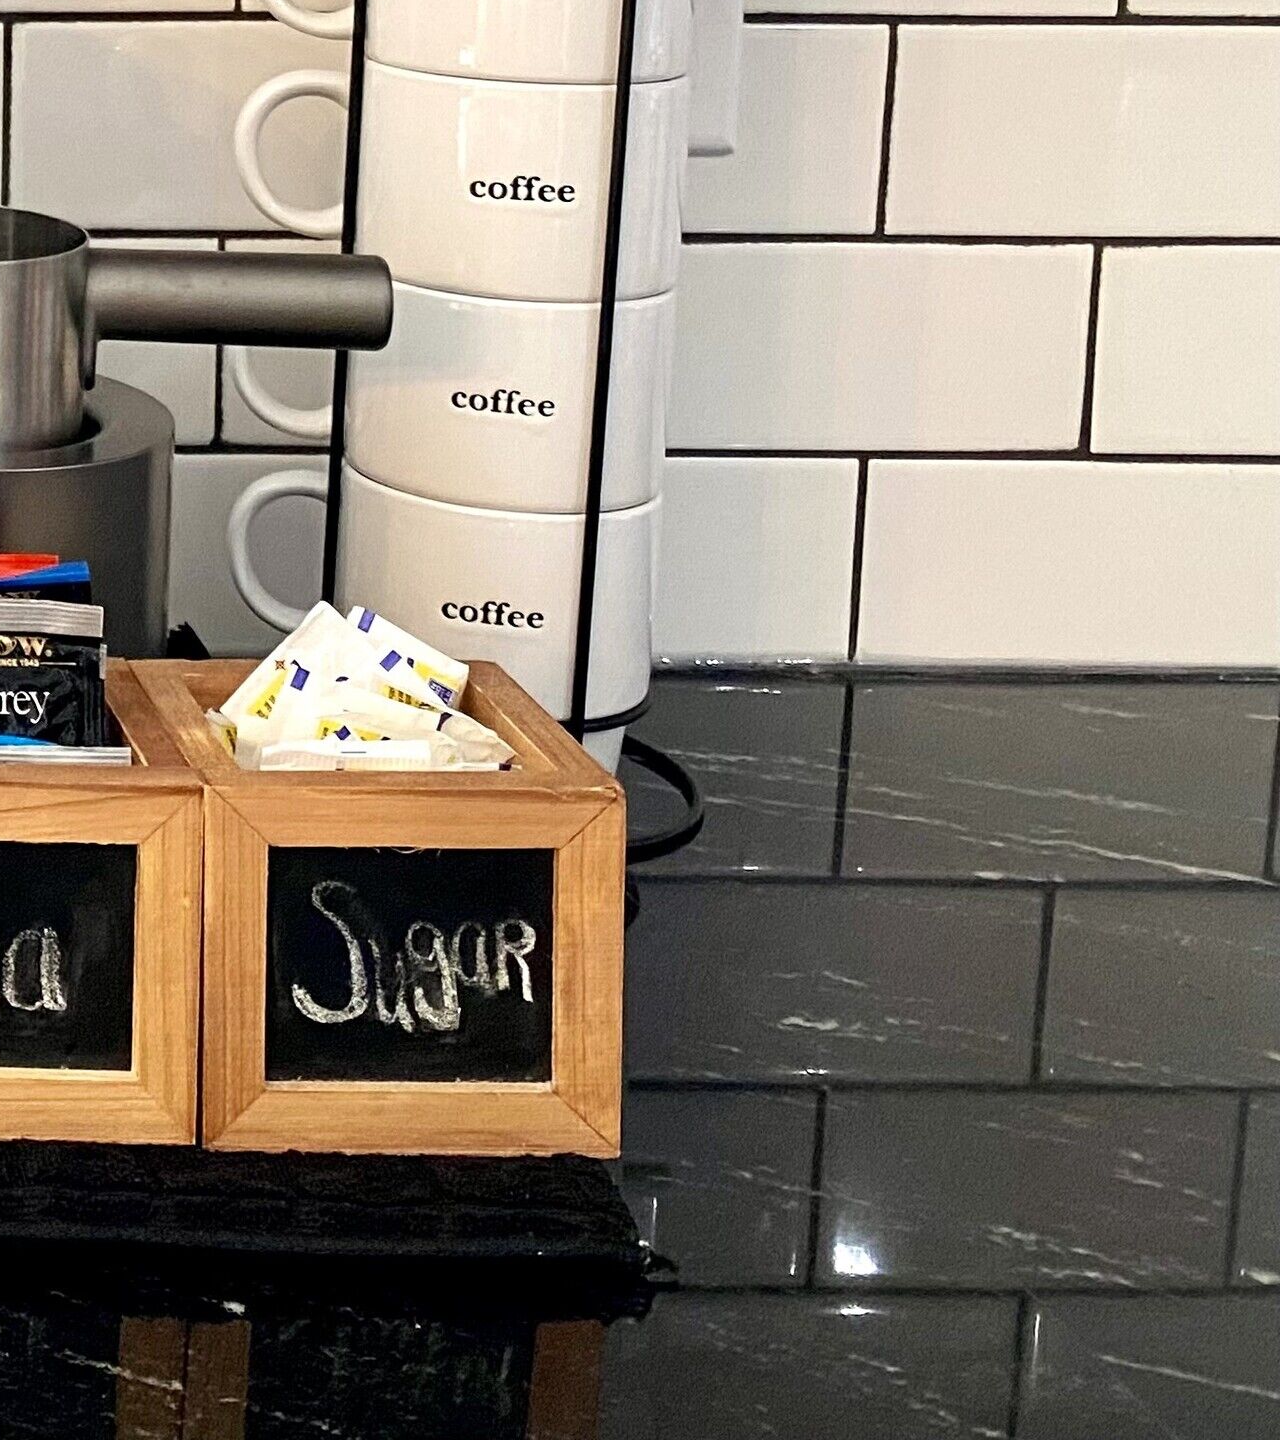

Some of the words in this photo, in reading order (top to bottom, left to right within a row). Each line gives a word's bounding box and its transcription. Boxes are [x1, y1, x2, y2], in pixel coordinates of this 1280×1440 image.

[469, 175, 575, 203] coffee
[451, 389, 555, 417] coffee
[441, 600, 544, 629] coffee
